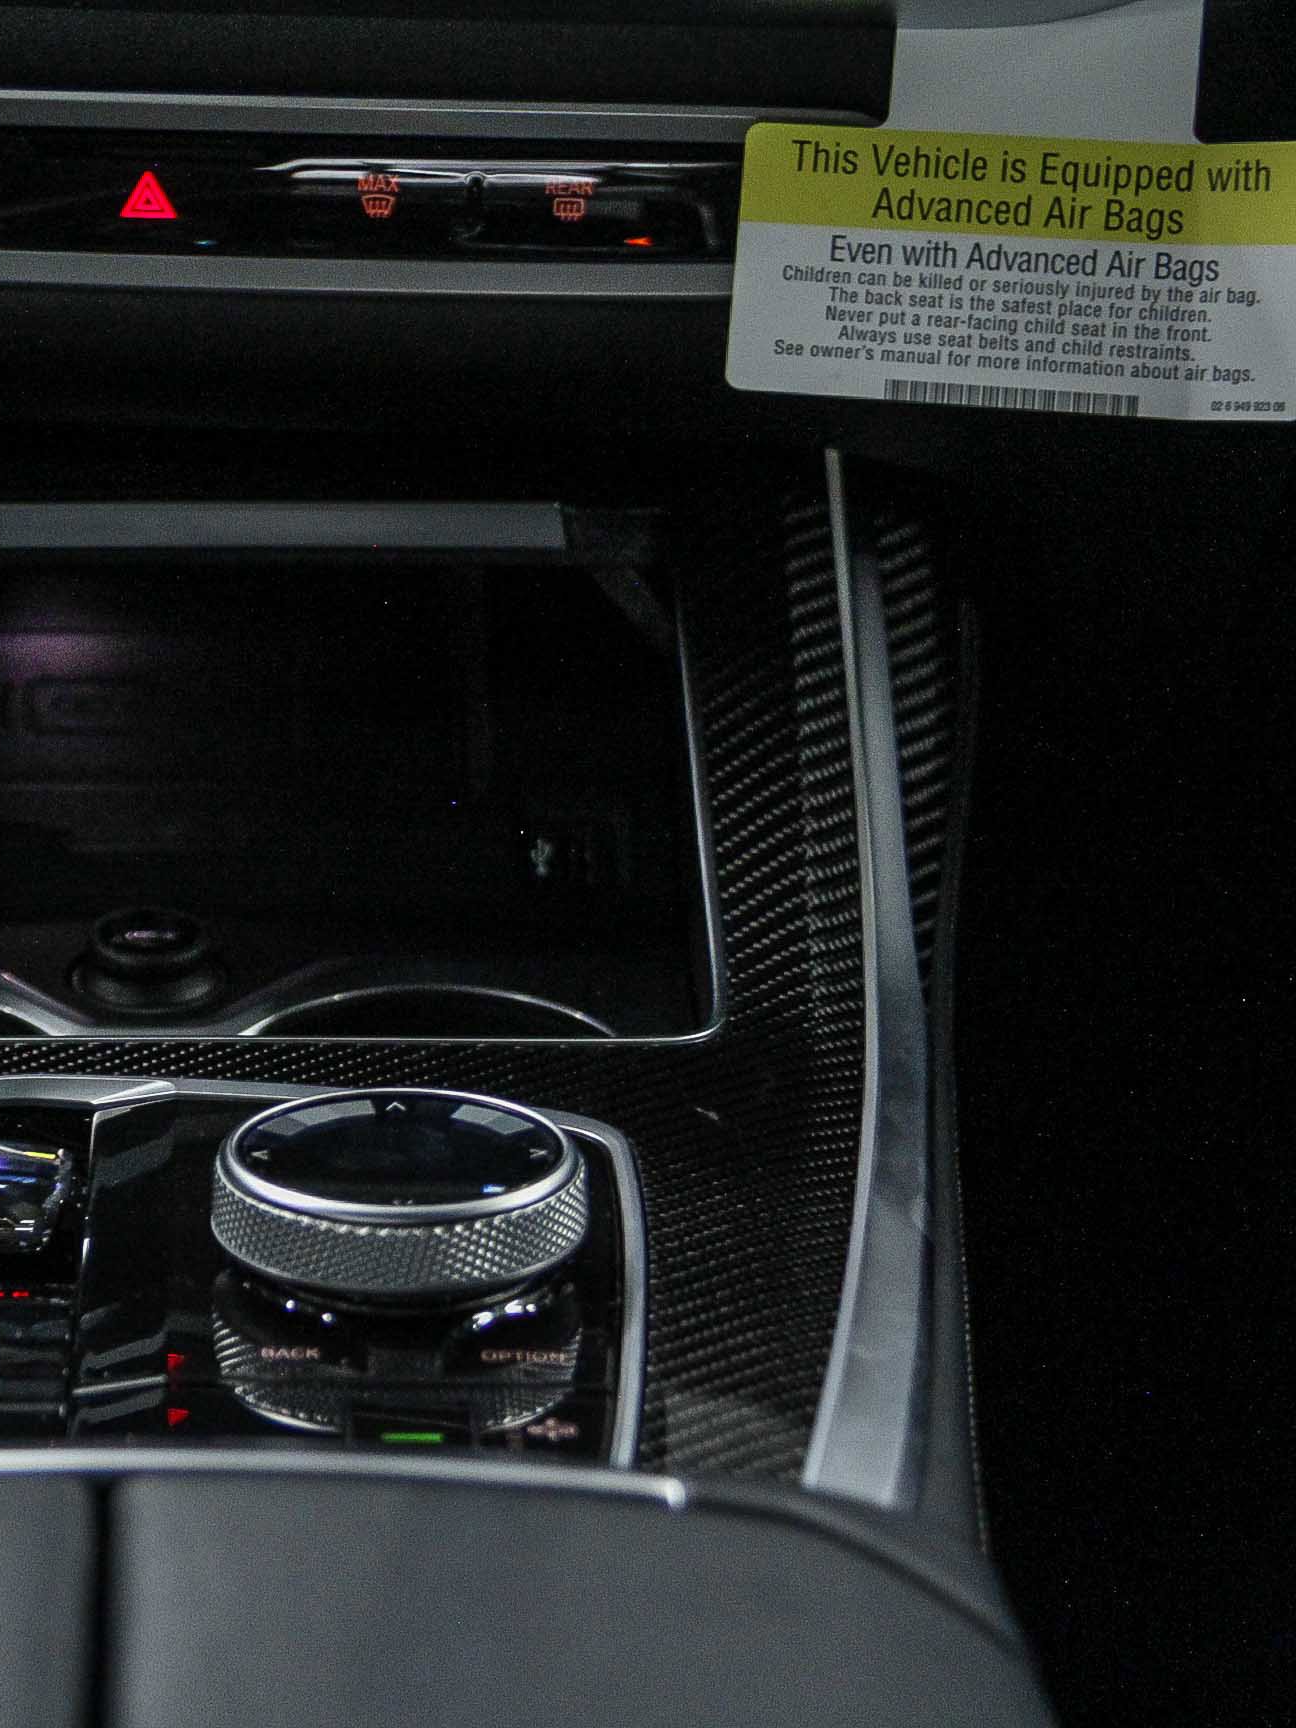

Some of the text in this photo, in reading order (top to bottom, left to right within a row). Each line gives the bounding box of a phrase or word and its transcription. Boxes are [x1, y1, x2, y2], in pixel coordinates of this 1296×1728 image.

[357, 175, 400, 193] MAX
[792, 140, 1270, 197] This Vehicle is Equipped with
[545, 181, 594, 196] REAR
[871, 187, 1184, 241] Advanced Air Bags
[830, 235, 1219, 288] Even with Advanced Air Bags
[783, 265, 1260, 307] Children can be killed or seriously injured by the air bag.
[828, 286, 1211, 322] The back seat is the safest place for children.
[826, 306, 1212, 342] Never put a rear-facing child seat in the front.
[838, 325, 1195, 361] Always use seat belts and child restraints.
[774, 340, 1255, 384] See owner's manual for more information about air bags.
[260, 1347, 321, 1360] BACK
[480, 1349, 568, 1363] OPTION
